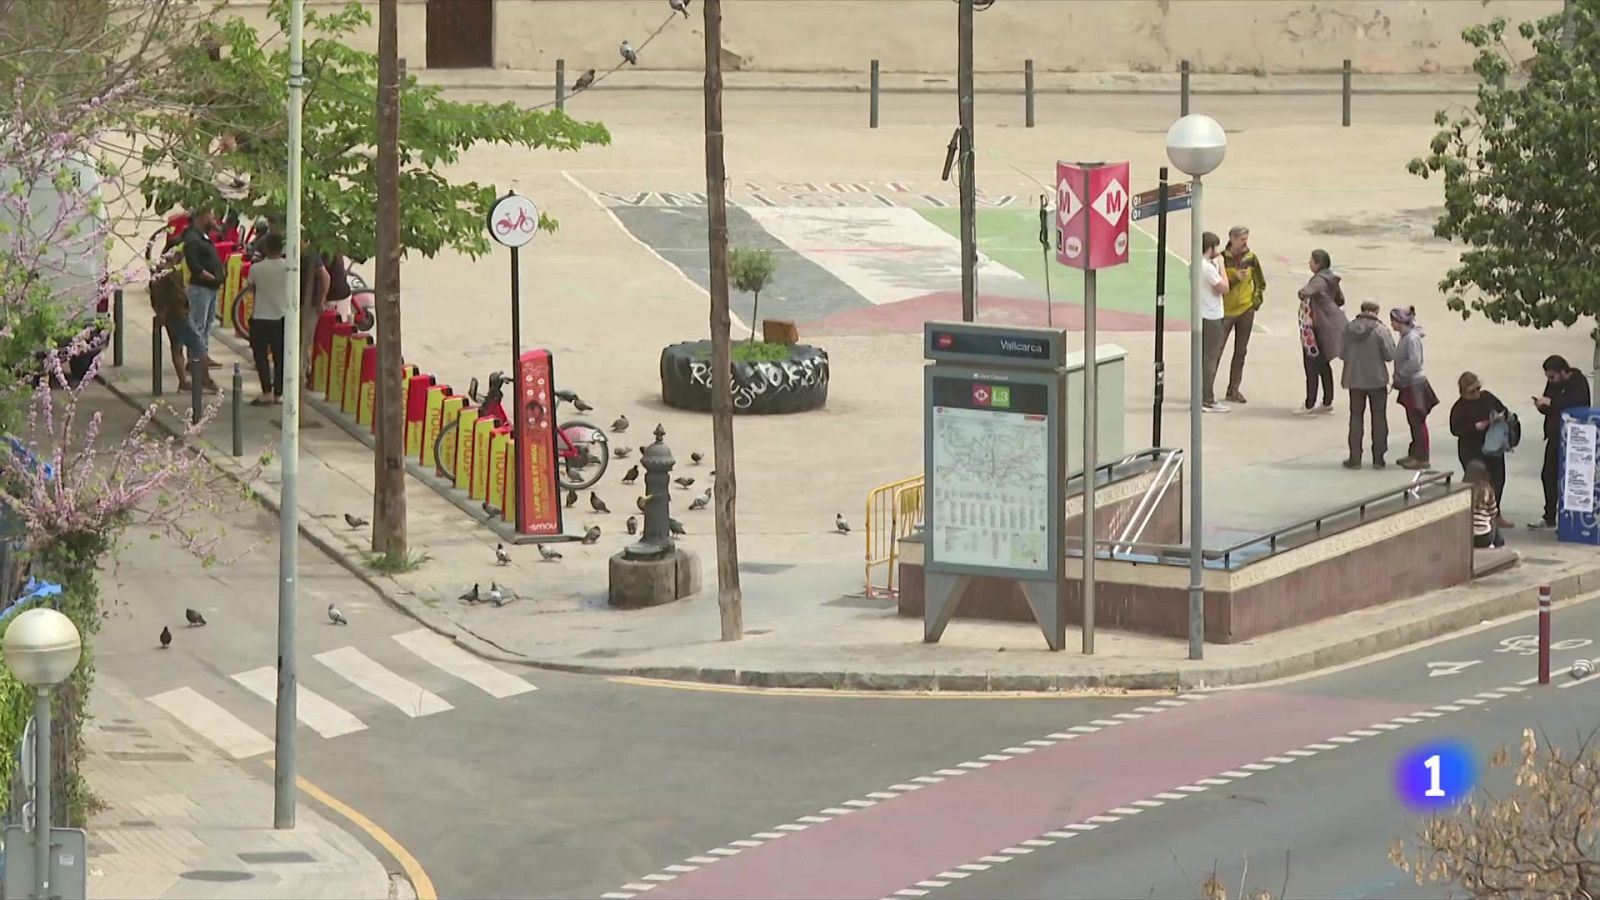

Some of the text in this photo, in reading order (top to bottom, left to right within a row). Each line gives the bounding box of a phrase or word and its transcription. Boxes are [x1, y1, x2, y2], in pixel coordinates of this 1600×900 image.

[1060, 190, 1070, 214] M
[1106, 190, 1121, 214] M
[1000, 339, 1043, 353] Vallcarca
[993, 390, 1009, 402] L3
[529, 521, 557, 531] smou
